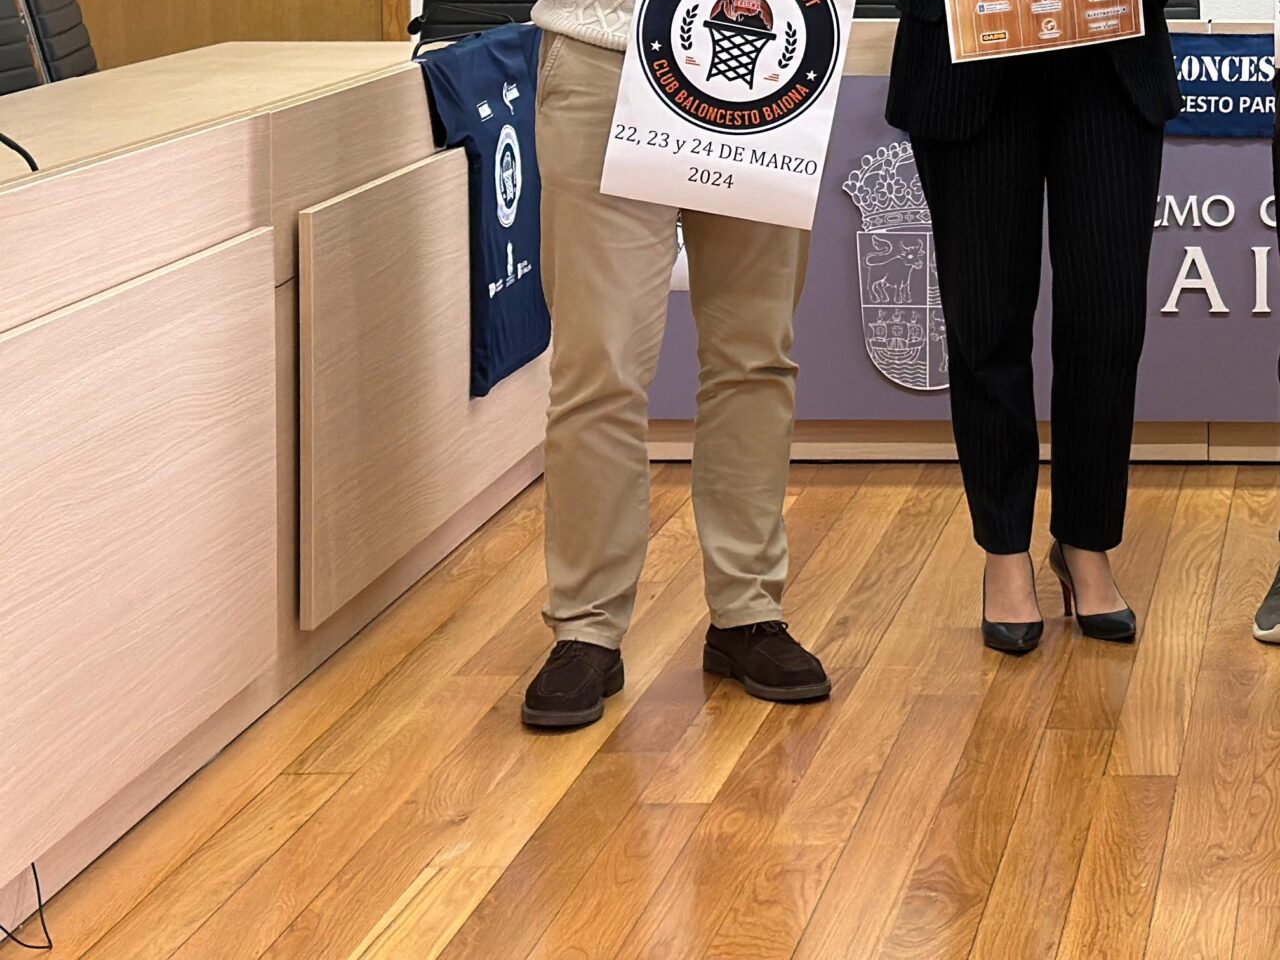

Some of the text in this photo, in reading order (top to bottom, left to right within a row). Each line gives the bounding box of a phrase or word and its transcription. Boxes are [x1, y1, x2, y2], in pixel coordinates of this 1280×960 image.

[652, 58, 810, 126] CLUB BALONCESTO BAIONA
[614, 123, 818, 176] 22, 23 y 24 DE MARZO
[687, 166, 734, 189] 2024
